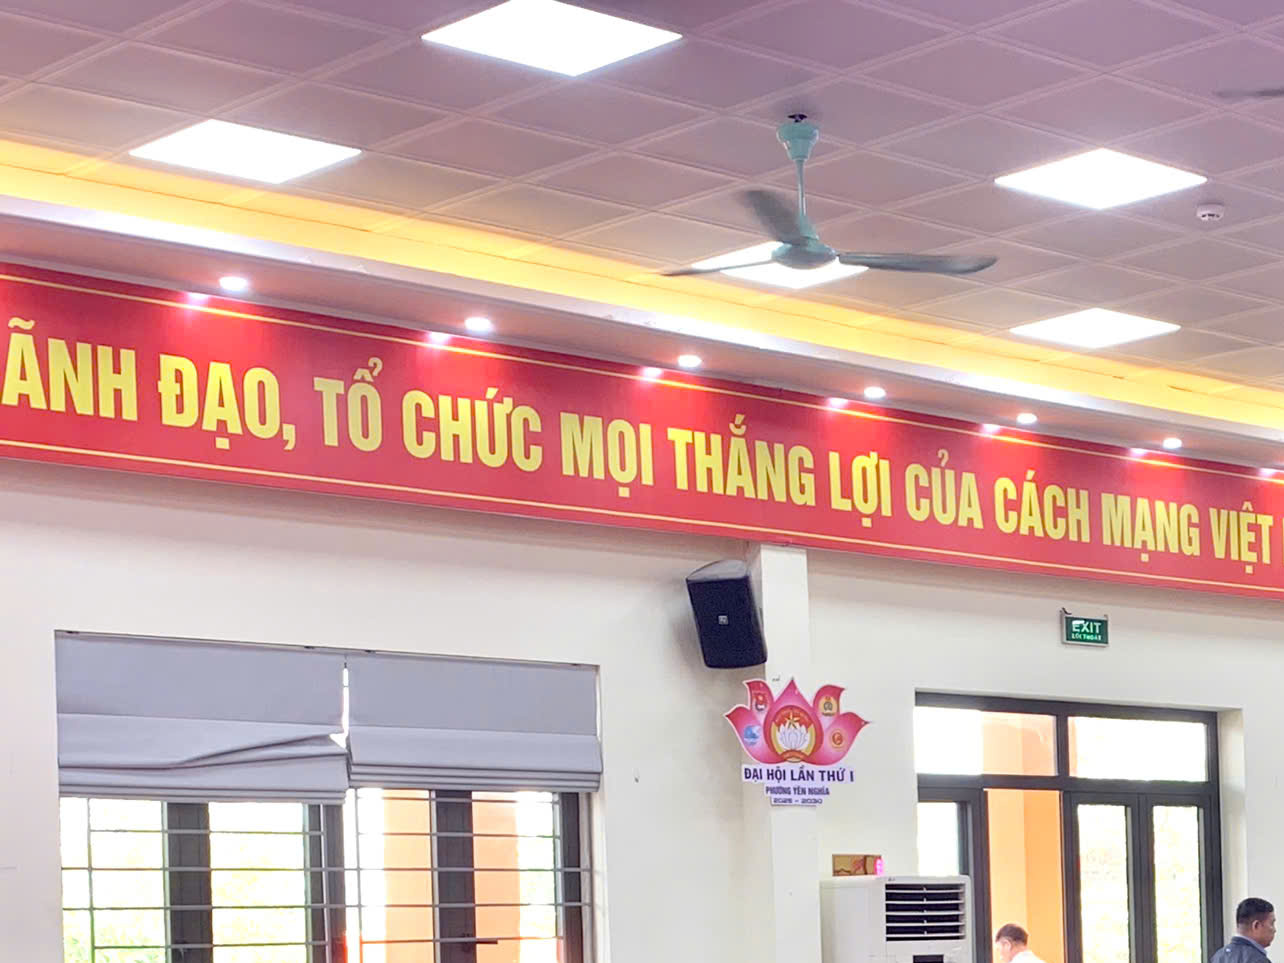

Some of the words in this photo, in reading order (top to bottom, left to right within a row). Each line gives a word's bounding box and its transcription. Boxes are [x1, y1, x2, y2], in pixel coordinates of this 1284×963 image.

[1, 317, 138, 421] ÃNH
[158, 354, 297, 450] ĐẠO,
[314, 356, 383, 452] TỔ
[402, 386, 542, 472] CHỨC
[560, 412, 654, 498] MỌI
[667, 413, 816, 507] THẮNG
[829, 451, 892, 528] LỢI
[905, 448, 984, 530] CỦA
[994, 469, 1090, 543] CÁCH
[1101, 493, 1201, 563] MẠNG
[1210, 501, 1274, 574] VIỆT
[1072, 620, 1101, 633] EXIT
[744, 767, 763, 782] ĐẠI
[767, 766, 786, 783] HỘI
[790, 765, 814, 781] LẦN
[818, 767, 845, 782] THỨ
[850, 770, 854, 782] I
